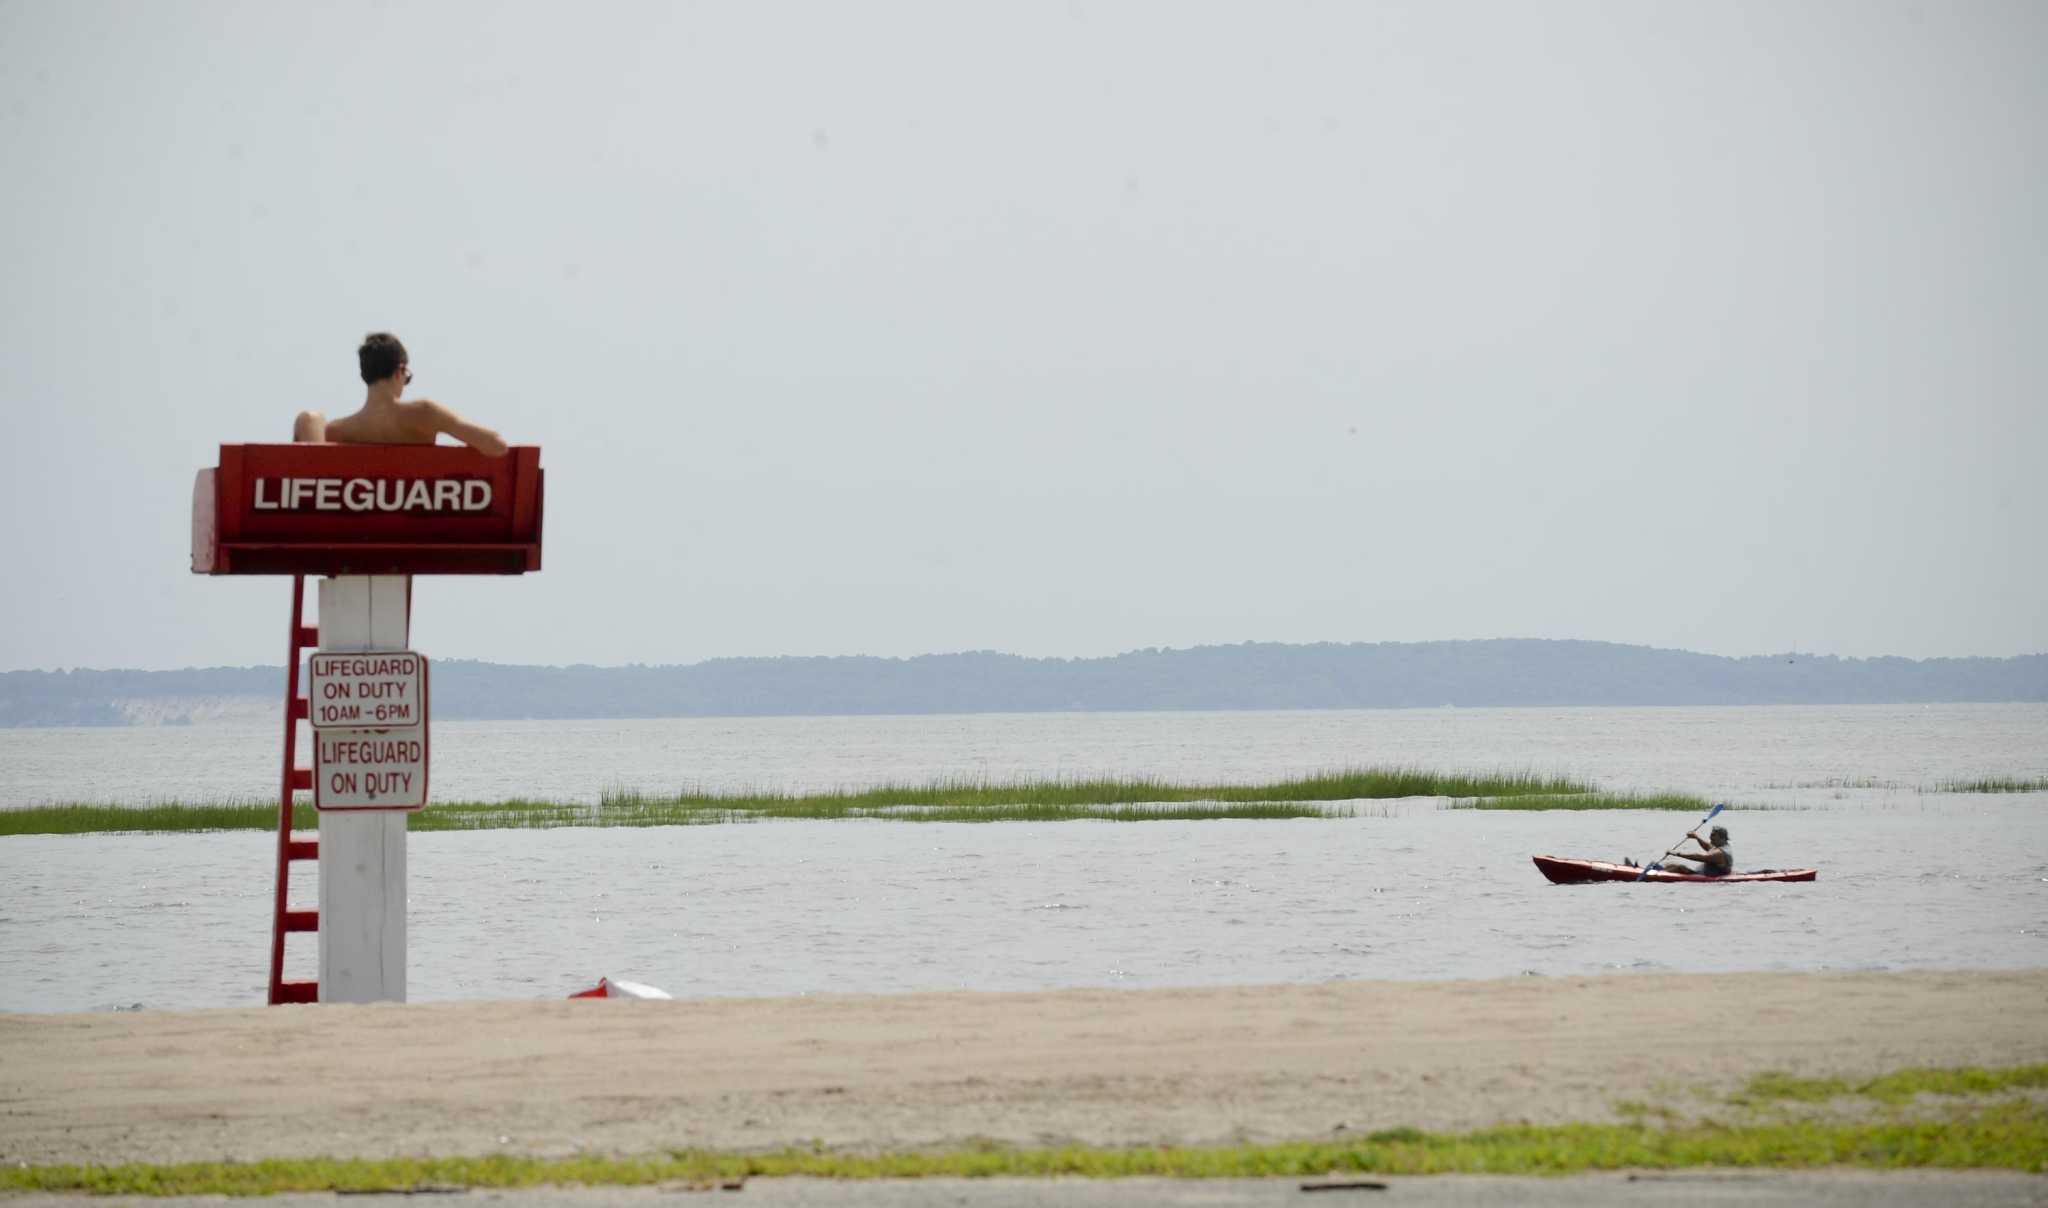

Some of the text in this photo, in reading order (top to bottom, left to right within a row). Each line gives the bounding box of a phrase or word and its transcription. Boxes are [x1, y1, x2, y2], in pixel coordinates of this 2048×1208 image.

[254, 478, 492, 511] LIFEGUARD
[315, 659, 415, 676] LIFEGUARD
[324, 681, 407, 699] ON DUTY
[320, 705, 360, 722] 10AM
[322, 741, 421, 764] LIFEGUARD
[331, 772, 412, 794] ON DUTY
